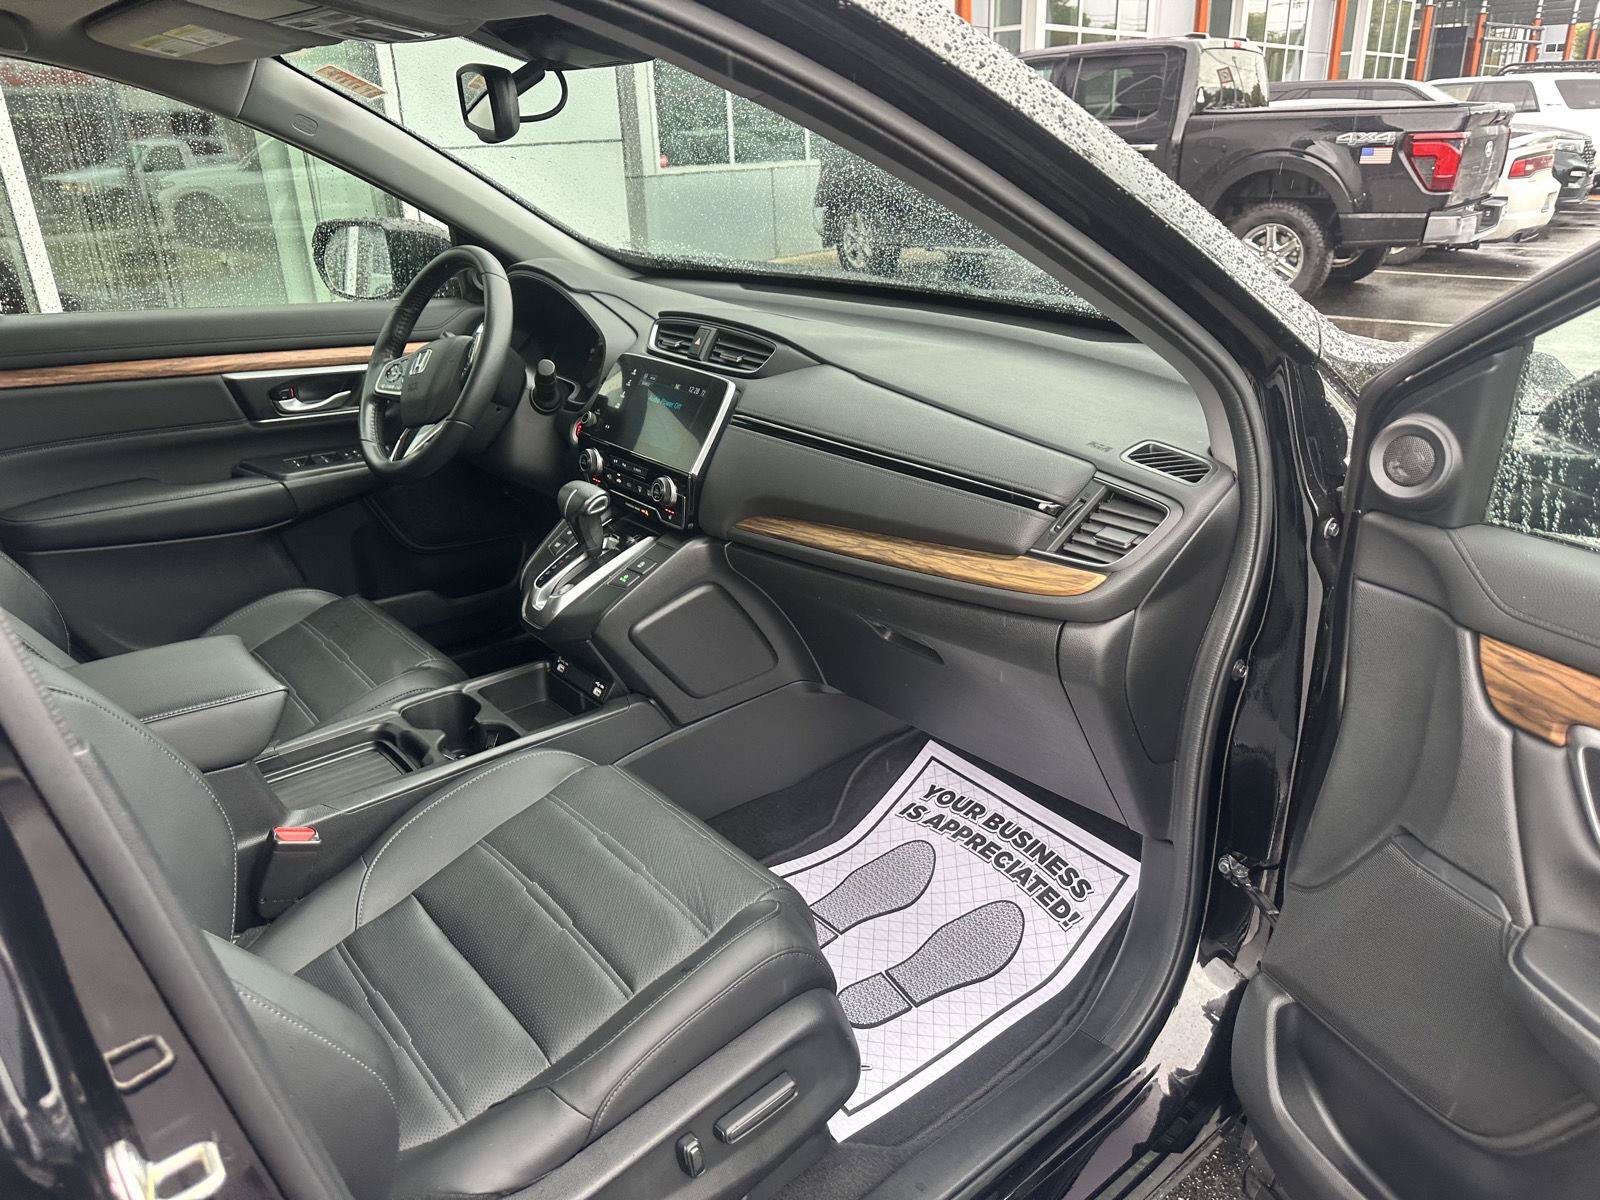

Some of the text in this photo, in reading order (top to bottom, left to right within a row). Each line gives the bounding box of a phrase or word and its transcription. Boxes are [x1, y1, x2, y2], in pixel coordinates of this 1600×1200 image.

[895, 802, 1084, 932] IS APPRECIATED!
[920, 783, 1094, 902] YOUR BUSINESS
